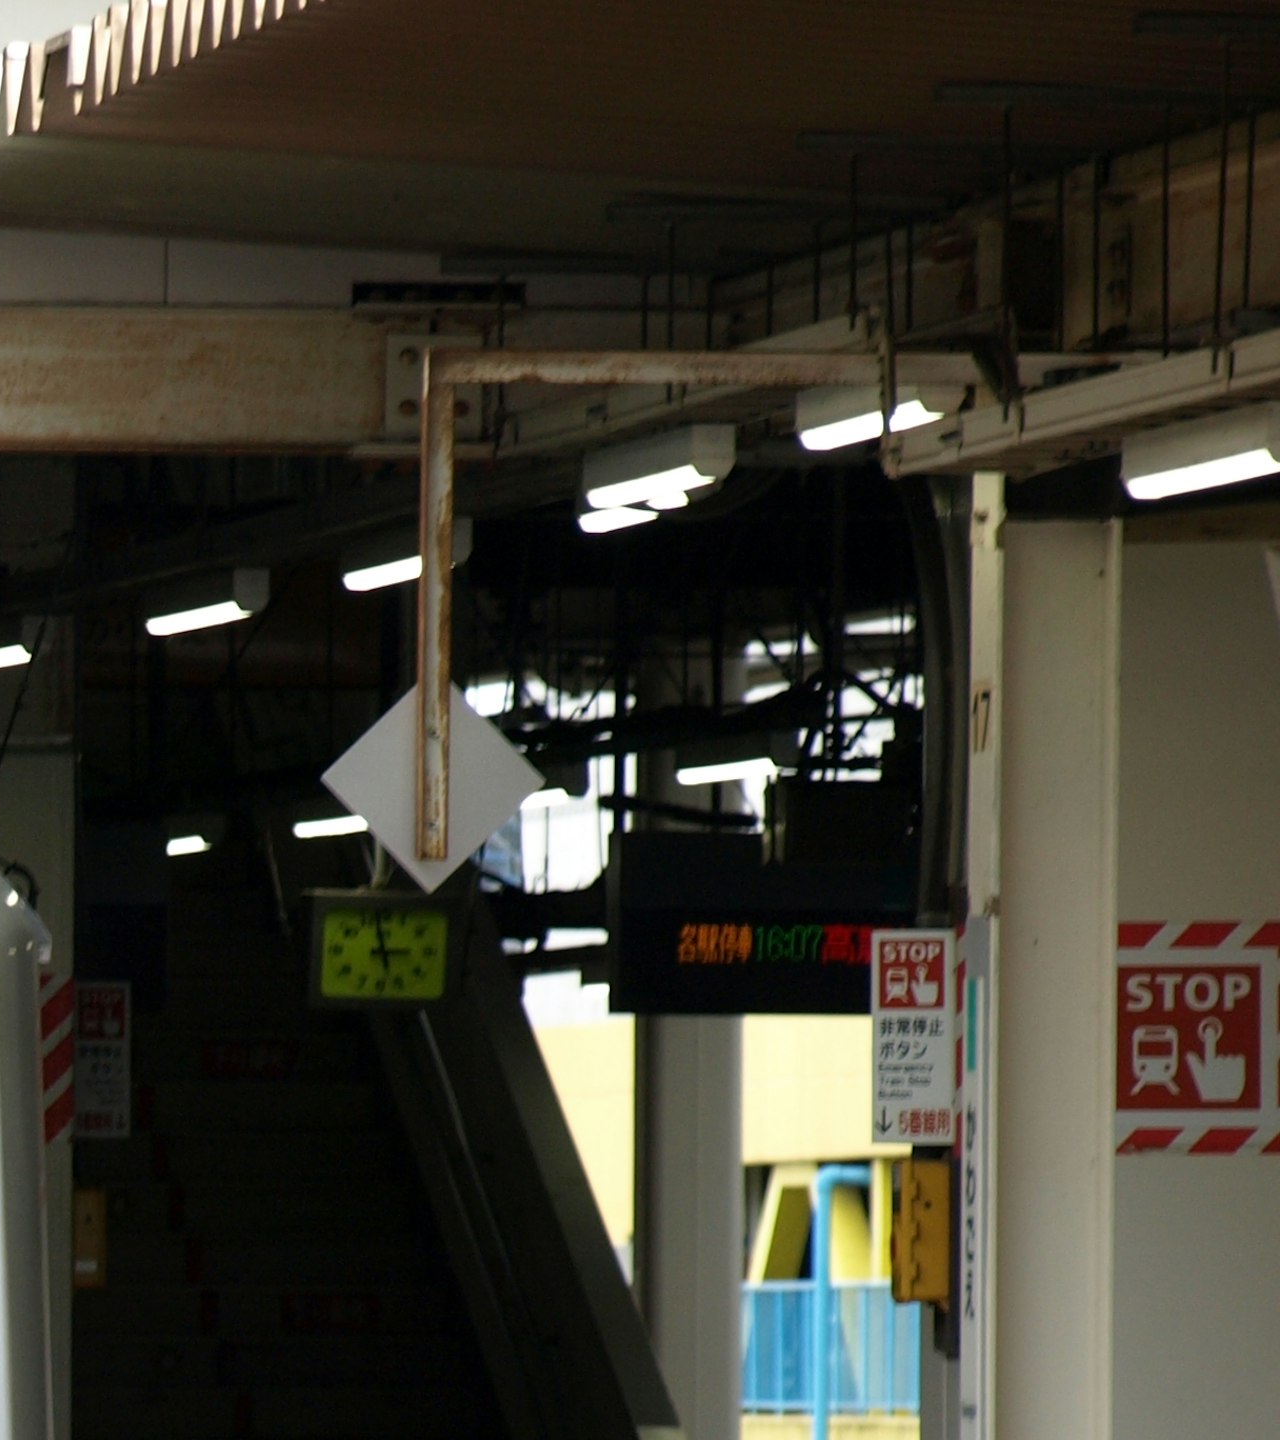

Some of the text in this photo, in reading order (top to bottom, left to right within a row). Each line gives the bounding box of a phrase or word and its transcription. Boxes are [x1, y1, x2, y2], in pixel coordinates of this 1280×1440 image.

[881, 942, 942, 963] STOP
[1125, 972, 1252, 1013] STOP
[879, 1015, 944, 1037] 非常停止
[879, 1039, 928, 1060] ボタン
